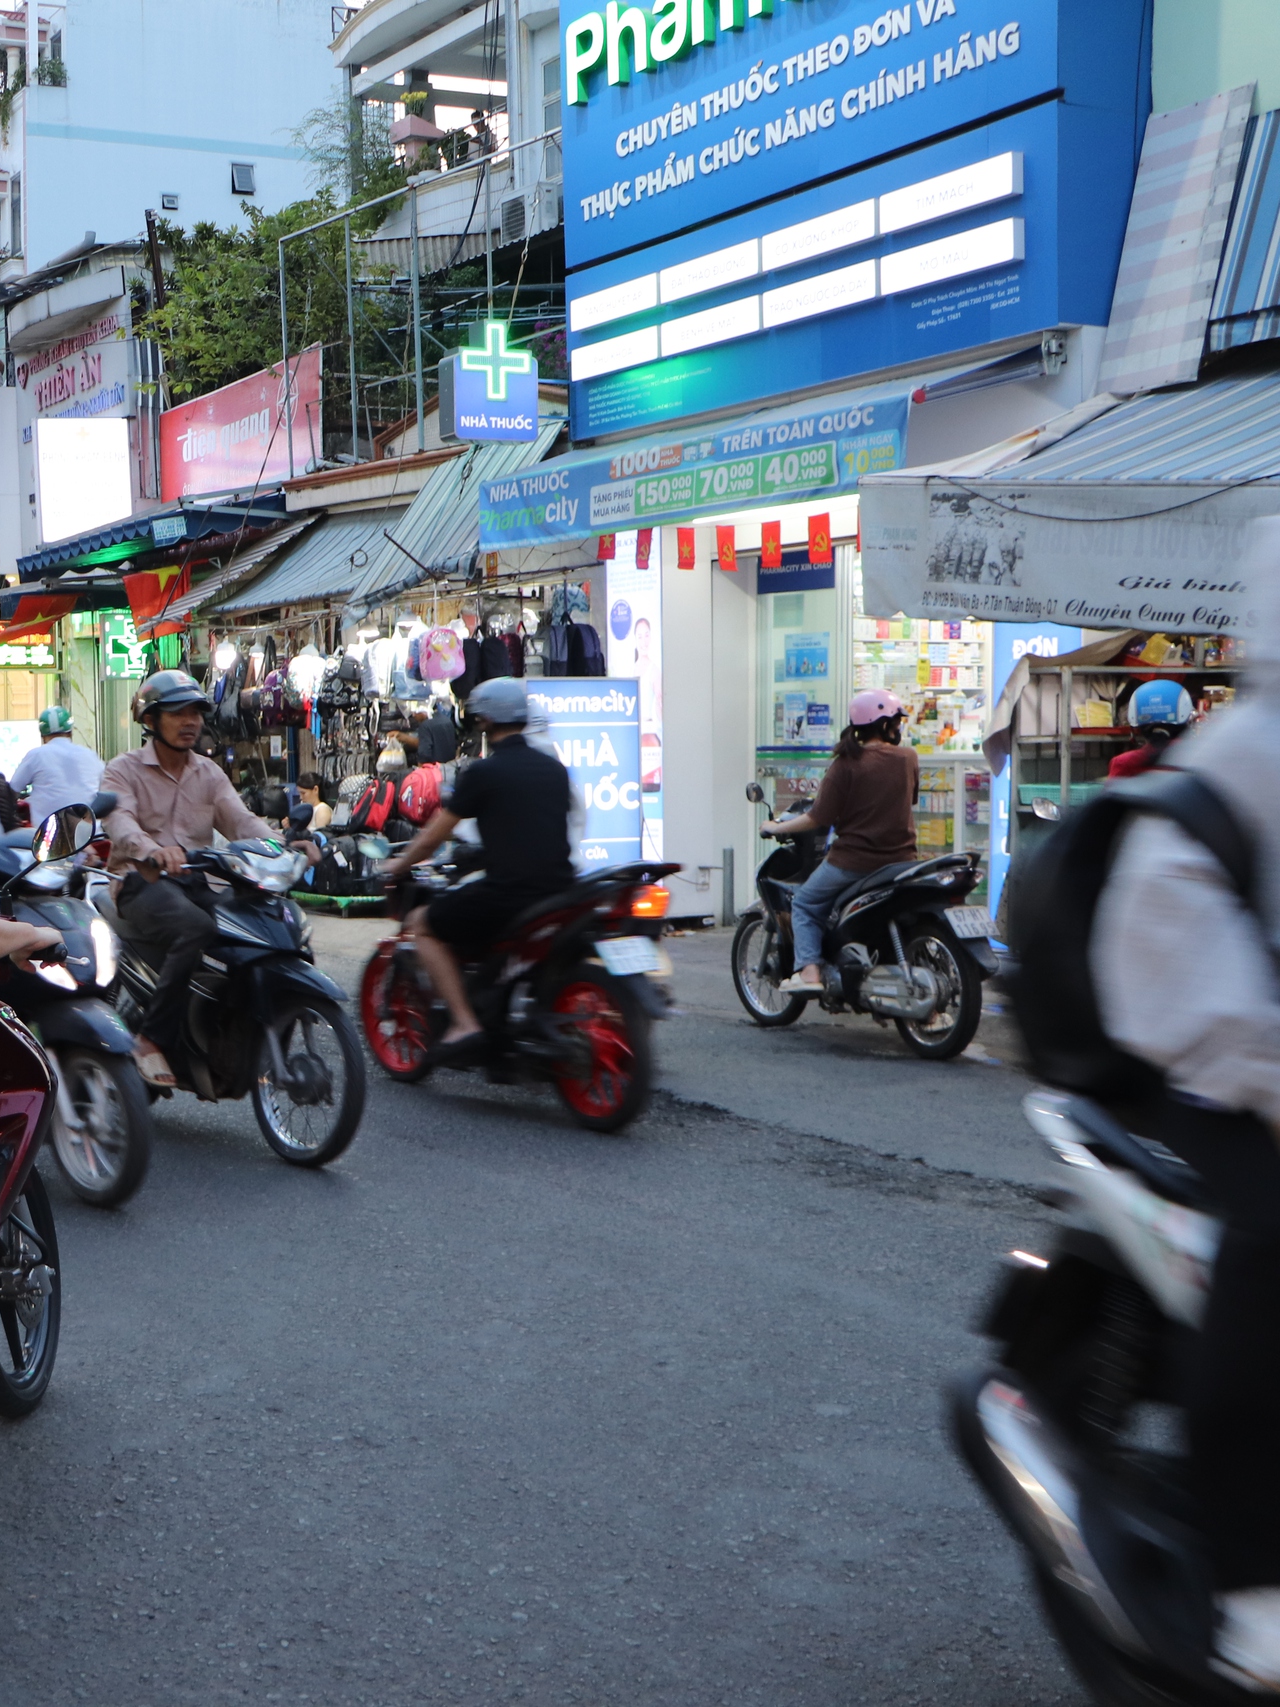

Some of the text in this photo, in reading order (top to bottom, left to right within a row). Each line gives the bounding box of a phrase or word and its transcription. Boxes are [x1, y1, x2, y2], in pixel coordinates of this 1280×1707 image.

[616, 102, 698, 157] CHUYÊN
[700, 60, 780, 121] THUỐC
[783, 34, 850, 86] THEO
[853, 4, 911, 56] ĐƠN
[581, 22, 1020, 222] THỰC PHẨM CHỨC NĂNG CHÍNH HÃNG
[98, 314, 119, 340] KHOA
[460, 413, 533, 430] NHÀ THUỐC
[722, 403, 875, 454] TRÊN TOÀN QUỐC
[177, 408, 270, 463] điện quang
[869, 433, 894, 446] NGAY
[660, 455, 681, 466] THUỐC
[661, 448, 674, 458] NHÀ
[843, 450, 870, 474] 10
[700, 467, 728, 498] 70
[730, 461, 754, 478] 000
[765, 448, 827, 485] 40 000
[490, 469, 570, 503] NHÀ THUỐC
[593, 485, 634, 507] TẶNG PHIẾU
[637, 479, 670, 507] 150
[671, 475, 692, 488] 000
[593, 508, 611, 519] MUA
[611, 502, 630, 515] HÀNG
[1117, 576, 1172, 590] Giá
[1065, 599, 1131, 620] Chuyên
[1138, 603, 1185, 627] Cung
[1192, 606, 1239, 629] Cấp:
[1012, 636, 1058, 660] ĐƠN
[553, 732, 619, 767] NHÀ
[586, 846, 608, 859] CỬA
